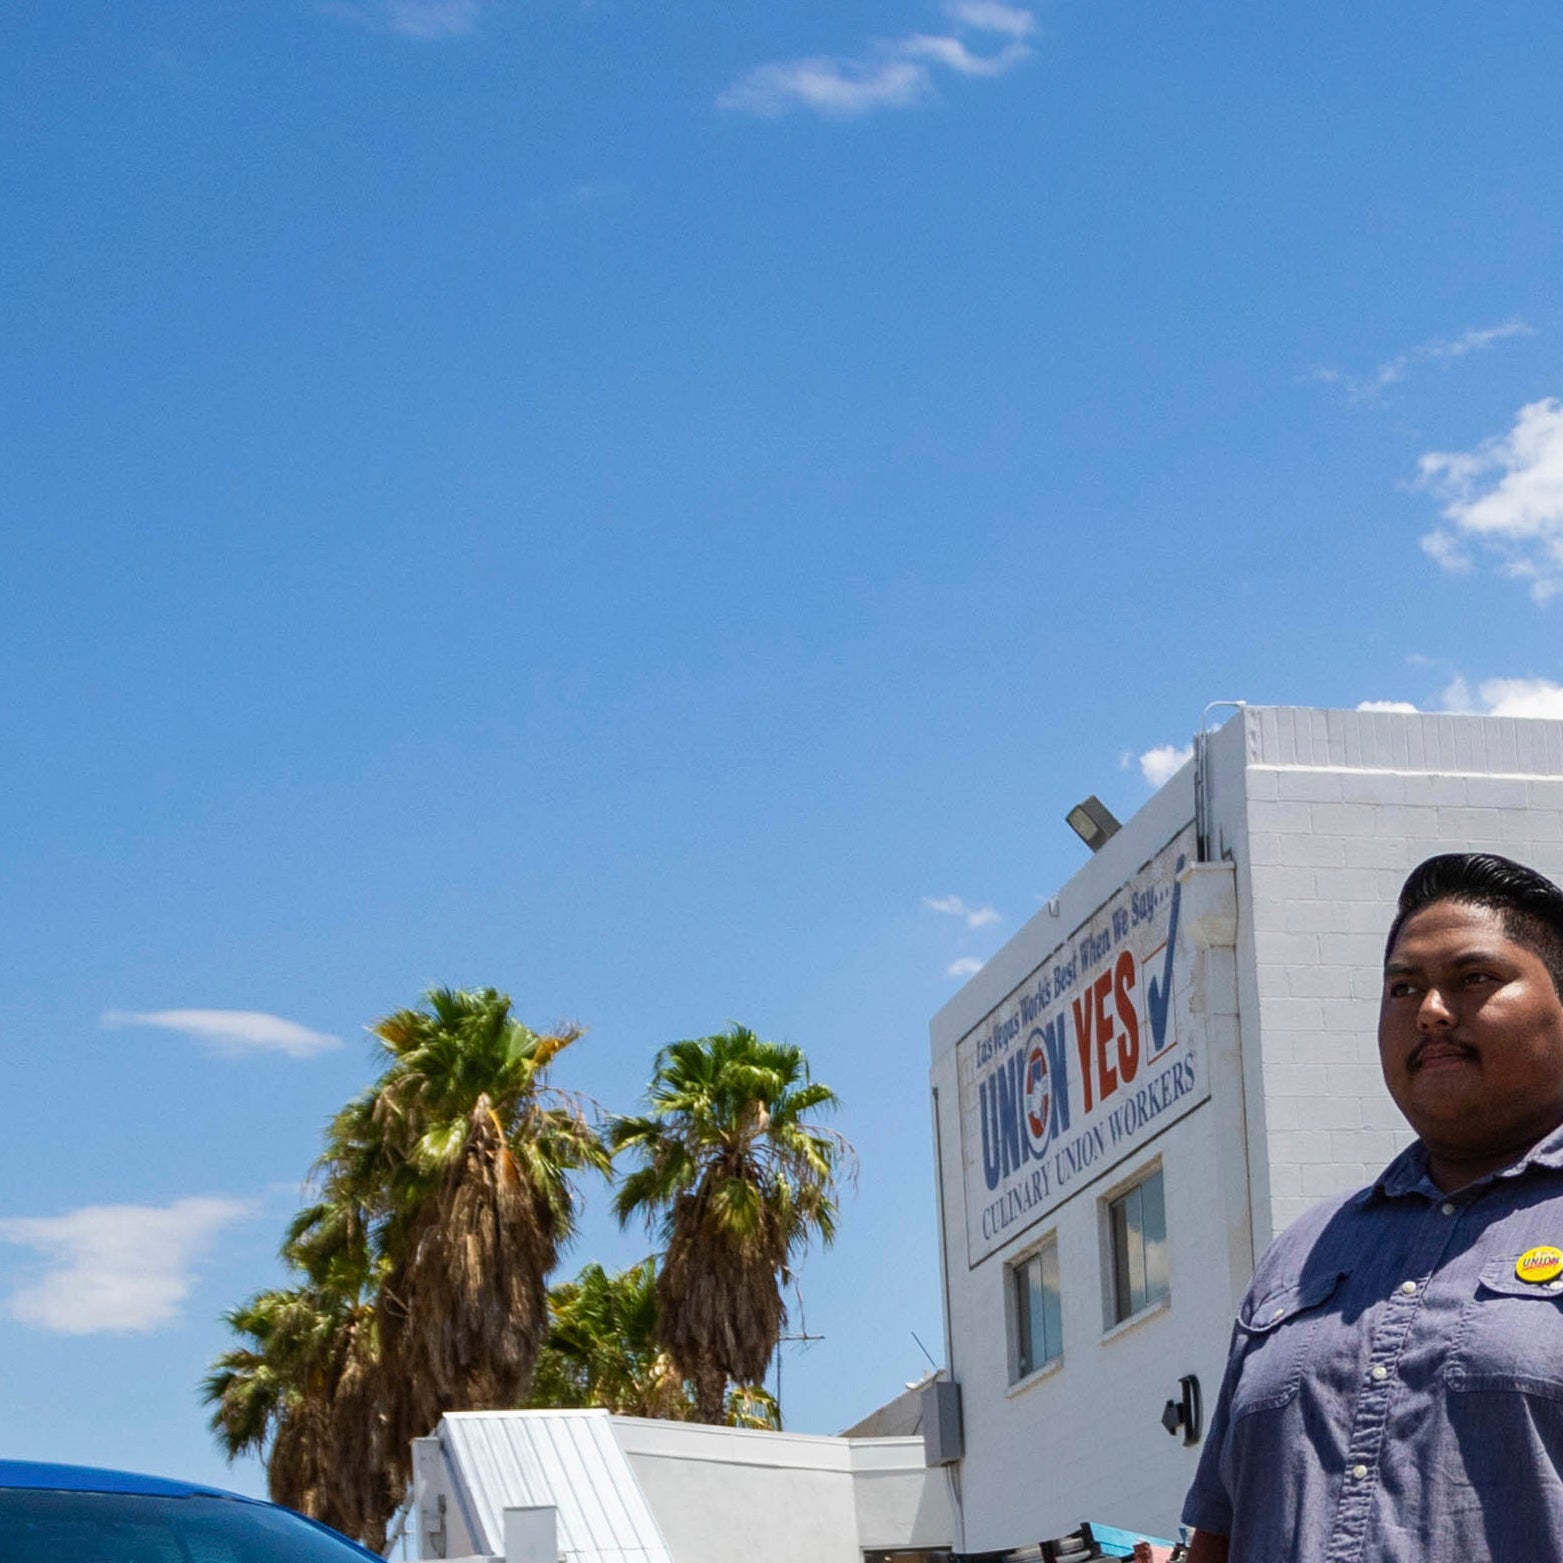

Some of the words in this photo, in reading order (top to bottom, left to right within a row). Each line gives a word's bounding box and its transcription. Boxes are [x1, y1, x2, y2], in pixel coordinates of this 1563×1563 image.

[976, 1038, 992, 1068] Las
[993, 1012, 1019, 1051] Vegas
[1054, 955, 1077, 999] Best
[1079, 928, 1111, 971] When
[1112, 907, 1128, 944] We
[979, 1012, 1070, 1191] UNION
[1072, 950, 1139, 1115] YES
[982, 1162, 1050, 1240] CULINARY
[1055, 1122, 1105, 1186] UNION
[1108, 1052, 1195, 1146] WORKERS
